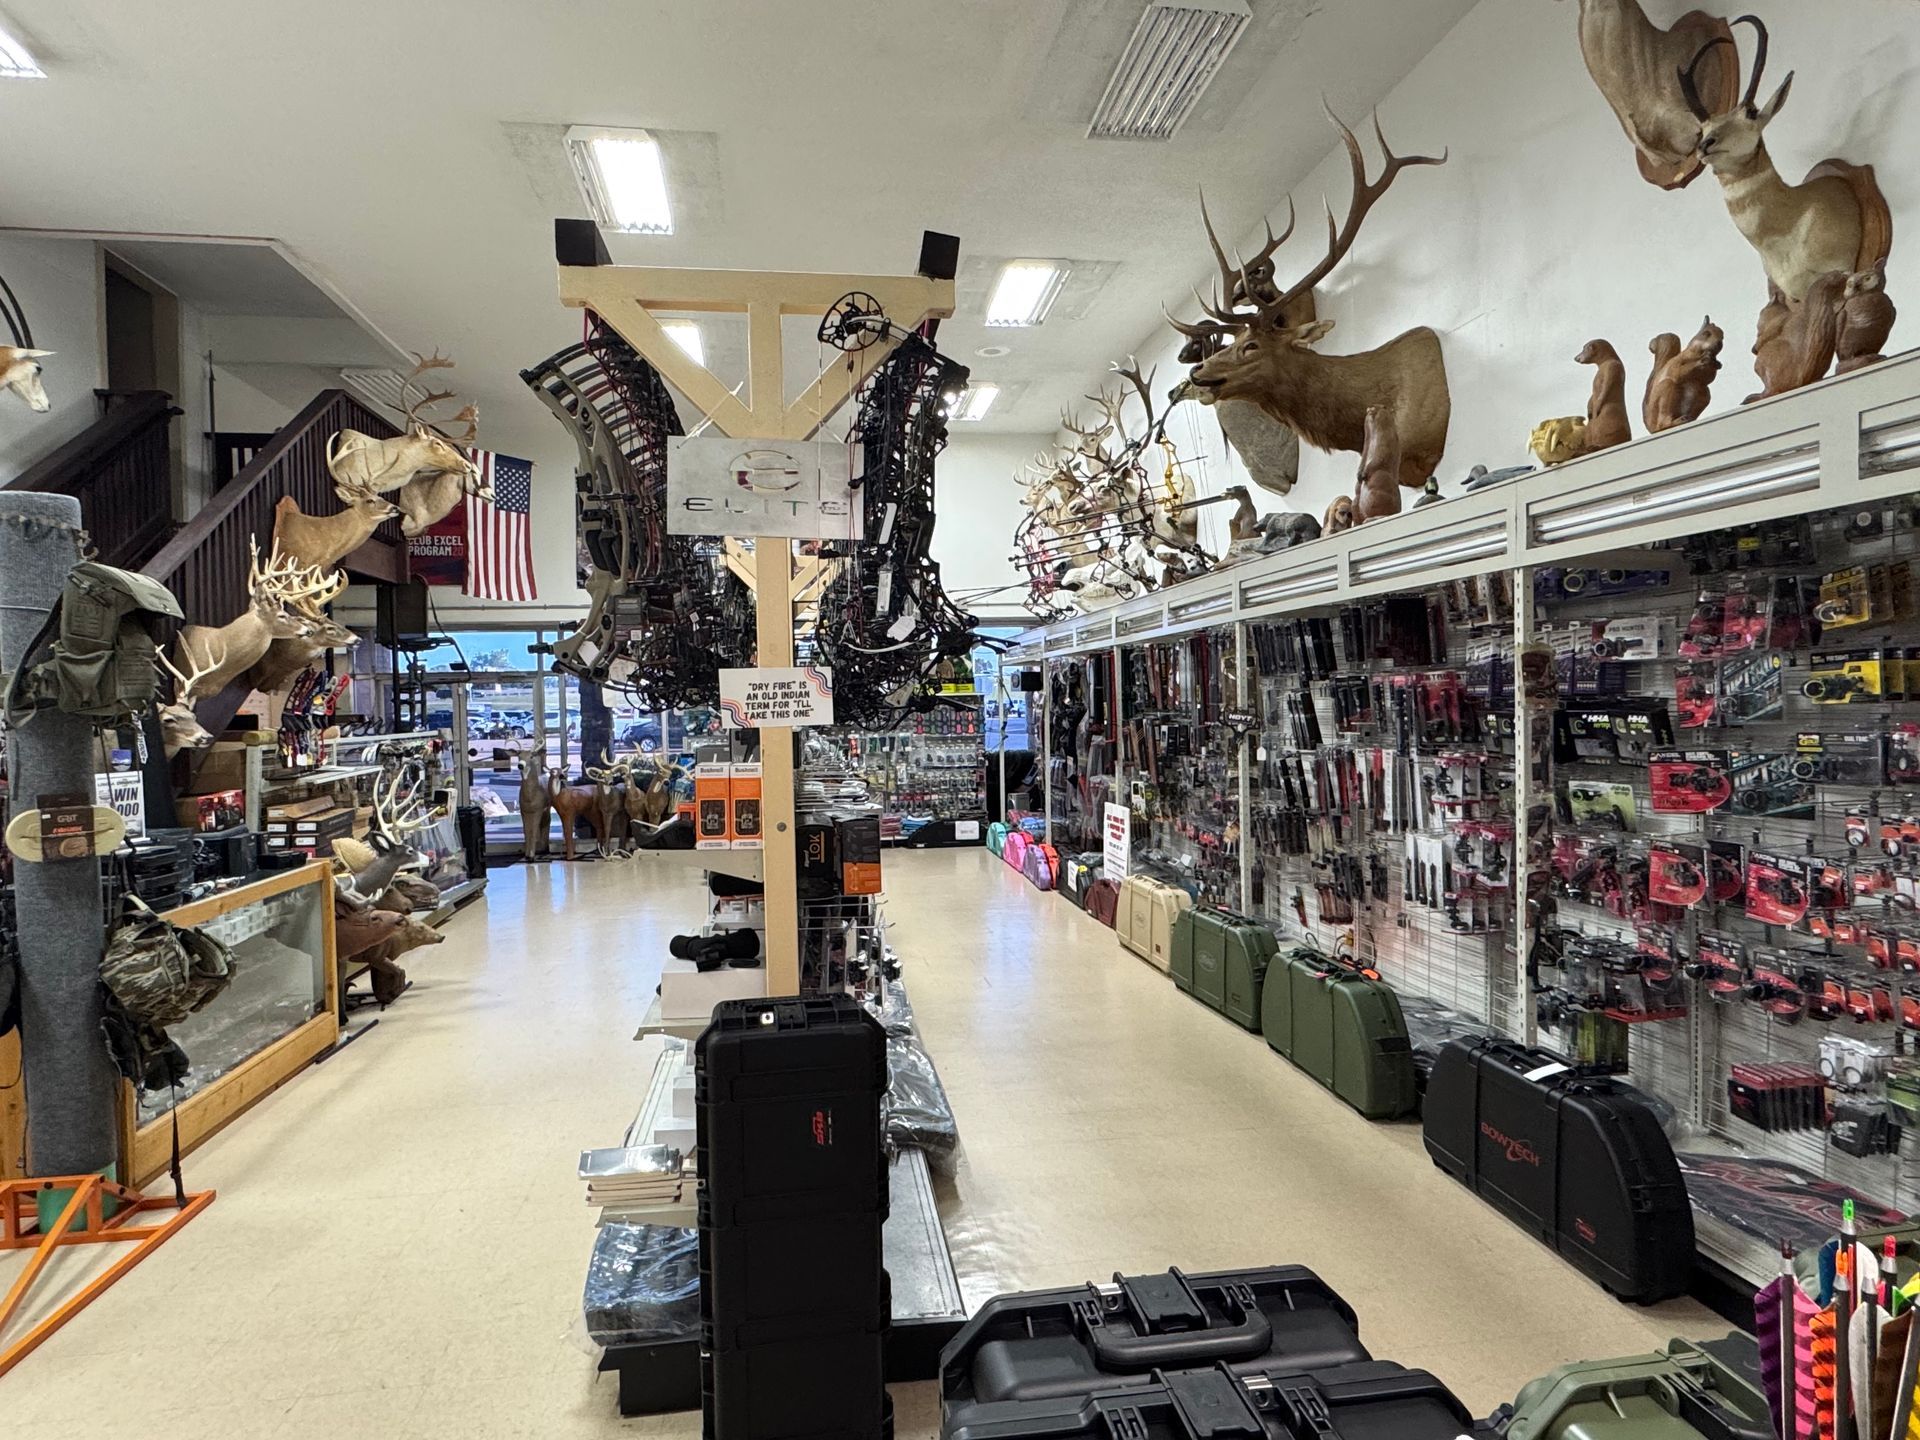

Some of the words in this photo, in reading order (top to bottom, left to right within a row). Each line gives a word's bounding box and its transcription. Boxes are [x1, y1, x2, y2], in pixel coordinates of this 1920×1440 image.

[683, 497, 848, 516] ELITE
[408, 535, 432, 546] CLUB
[433, 535, 464, 546] EXCEL
[408, 546, 452, 556] PROGRAM
[748, 682, 770, 691] "DRY
[773, 680, 796, 691] FIRE"
[799, 681, 807, 690] IS
[746, 693, 758, 701] AN
[761, 691, 778, 700] OLD
[781, 690, 810, 699] INDIAN
[745, 702, 770, 711] TERM
[773, 701, 790, 709] FOR
[744, 711, 767, 720] TAKE
[771, 710, 790, 719] THIS
[793, 708, 814, 718] ONE"
[1228, 713, 1252, 721] HOYT
[114, 787, 138, 802] WIN
[809, 834, 820, 860] LOK
[1480, 1121, 1541, 1168] BOWTECH
